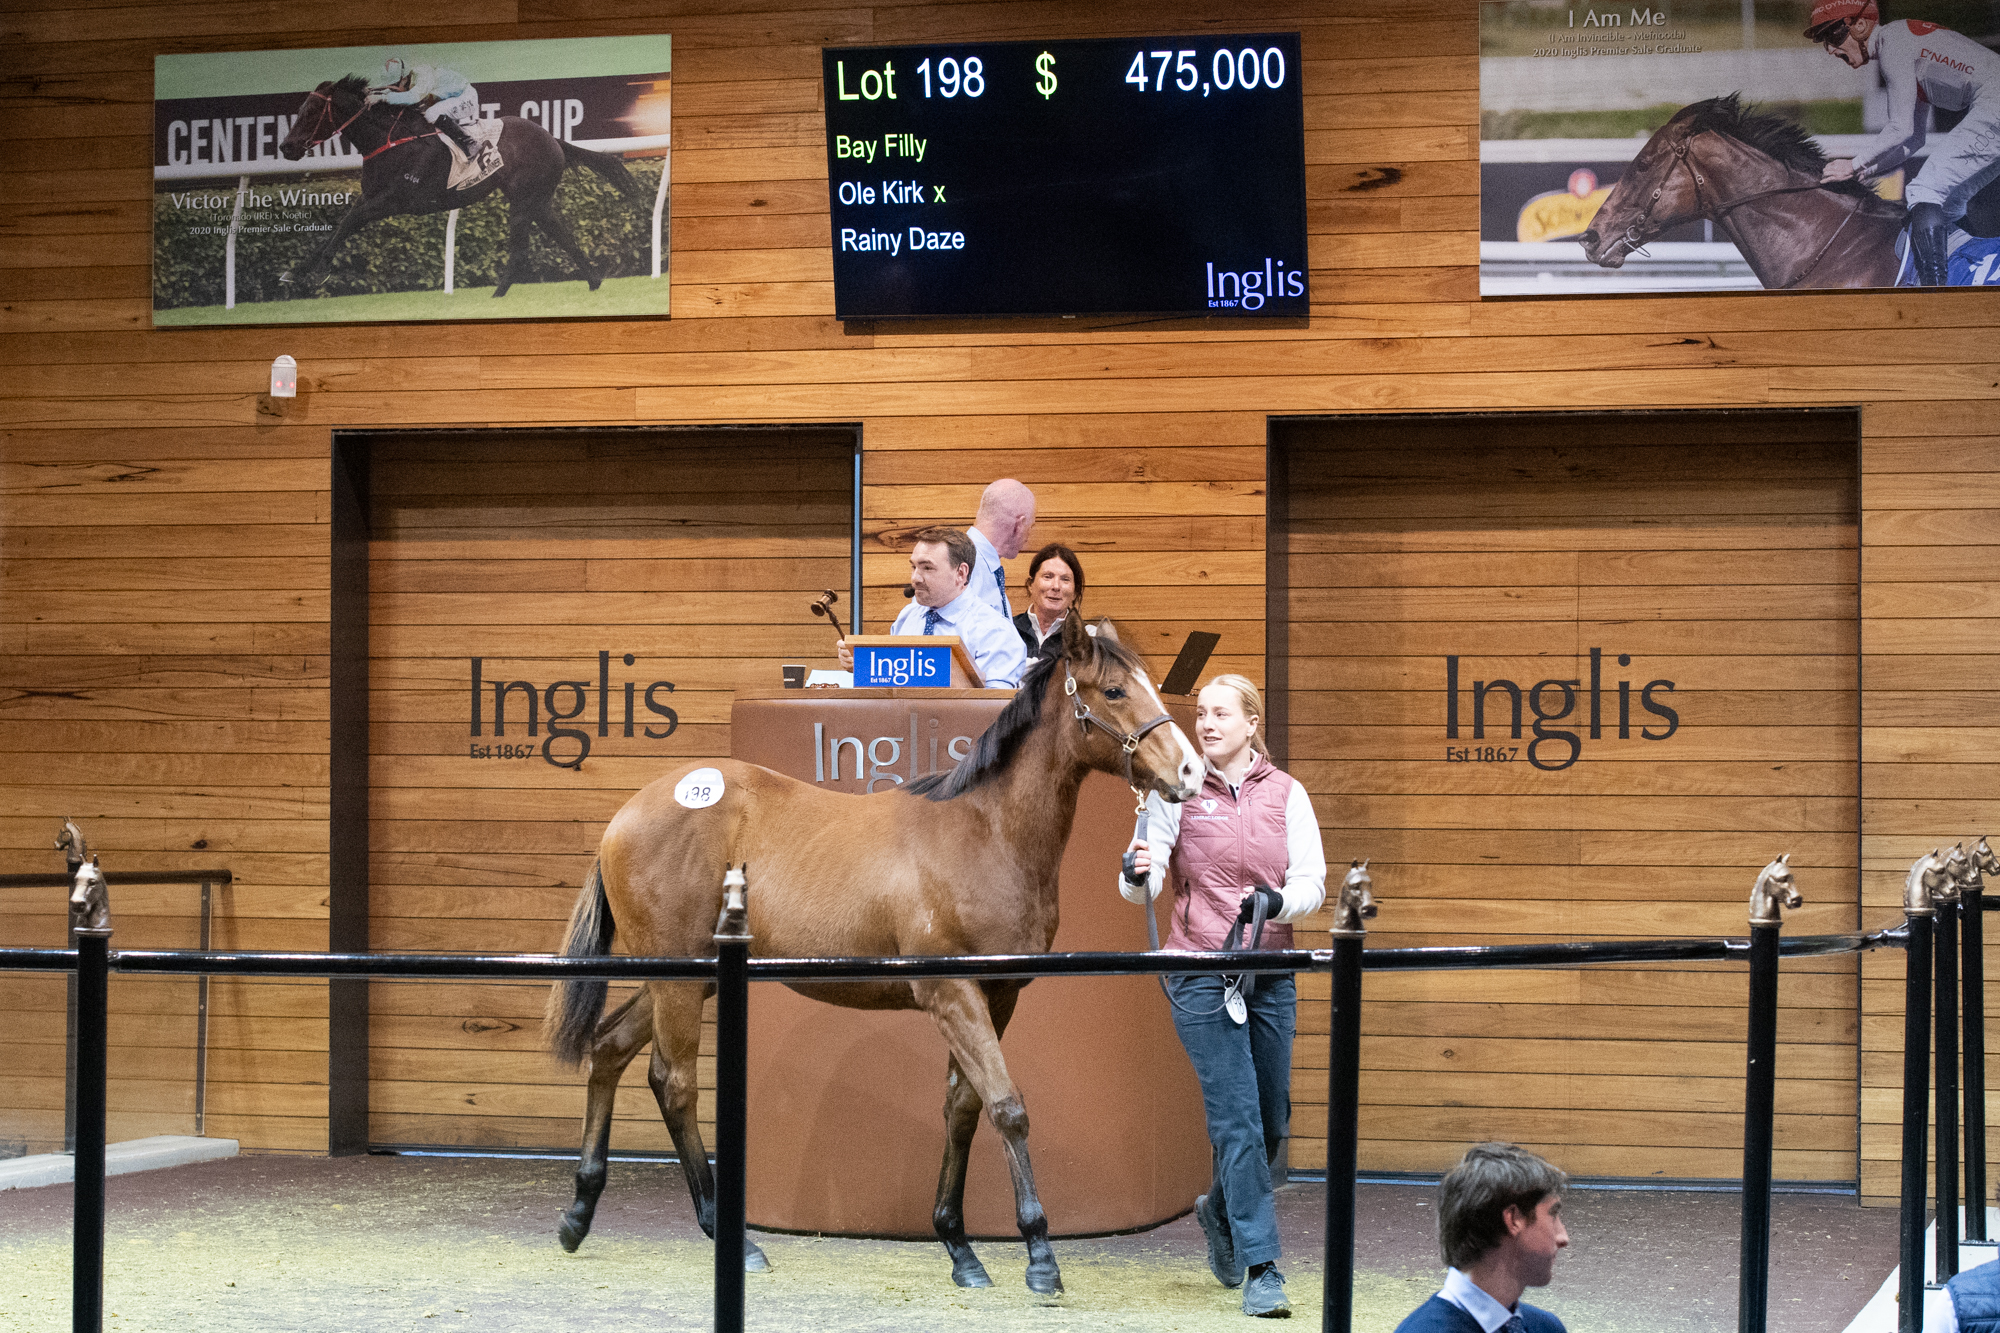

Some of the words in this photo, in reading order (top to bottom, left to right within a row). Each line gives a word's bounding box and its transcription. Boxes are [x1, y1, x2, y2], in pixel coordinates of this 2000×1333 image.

[1568, 9, 1575, 28] I
[1582, 8, 1621, 28] Am
[1629, 7, 1667, 27] Me
[1558, 33, 1575, 43] Am
[1577, 32, 1625, 43] Invincible
[1532, 47, 1559, 57] 2020
[1561, 46, 1588, 59] Inglis
[1590, 45, 1629, 56] Premier
[1631, 43, 1652, 54] Sale
[1655, 43, 1702, 55] Graduate
[1920, 48, 1975, 75] DNAMIC
[837, 60, 898, 101] Lot
[916, 56, 985, 99] 198
[1035, 50, 1058, 100] $
[1125, 47, 1286, 98] 475,000
[836, 134, 877, 163] Bay
[884, 133, 927, 162] Filly
[170, 193, 230, 210] Victor
[236, 189, 273, 208] The
[279, 187, 353, 206] Winner
[838, 181, 875, 205] Ole
[882, 180, 925, 204] Kirk
[933, 185, 947, 203] x
[209, 213, 252, 222] (Toronado
[253, 211, 273, 221] (IRE)
[281, 211, 312, 220] Noetic)
[189, 226, 211, 235] 2020
[213, 225, 237, 236] Inglis
[238, 224, 271, 234] Premier
[273, 223, 291, 233] Sale
[293, 222, 333, 233] Graduate
[841, 228, 902, 257] Rainy
[909, 226, 966, 251] Daze
[1206, 257, 1305, 311] Inglis
[1208, 300, 1219, 308] Est
[1220, 299, 1239, 308] 1867
[870, 649, 937, 685] Inglis
[470, 650, 679, 769] Inglis
[1445, 647, 1680, 771] Inglis
[470, 744, 491, 759] Est
[495, 744, 535, 760] 1867
[1446, 747, 1470, 762] Est
[1474, 746, 1519, 763] 1867
